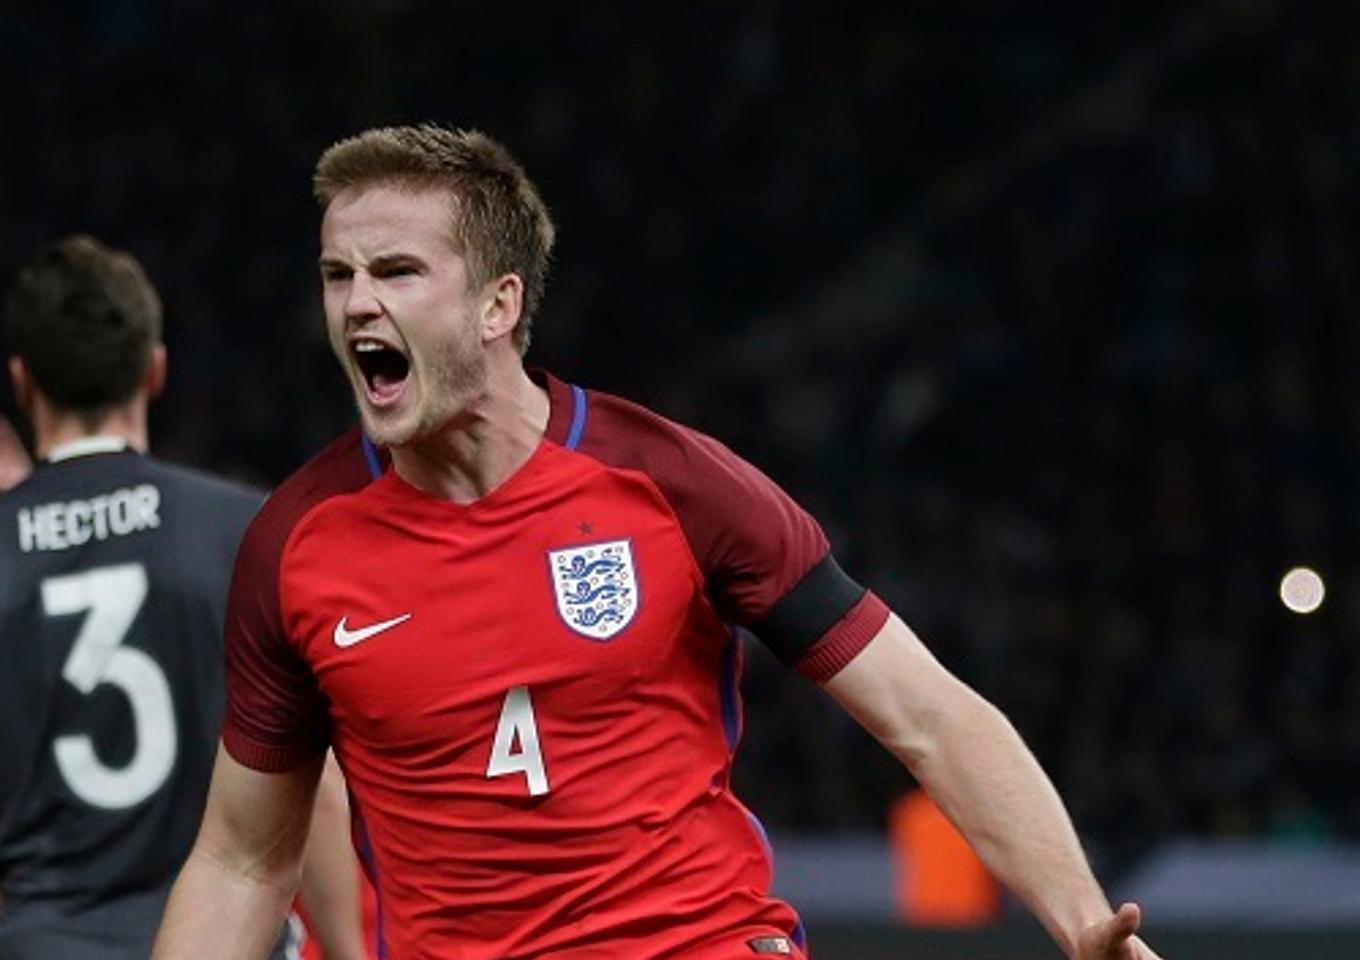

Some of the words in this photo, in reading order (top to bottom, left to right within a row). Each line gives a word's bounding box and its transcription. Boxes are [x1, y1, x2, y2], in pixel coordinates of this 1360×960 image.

[18, 484, 161, 553] HECTOR
[42, 562, 177, 810] 3
[486, 685, 549, 796] 4
